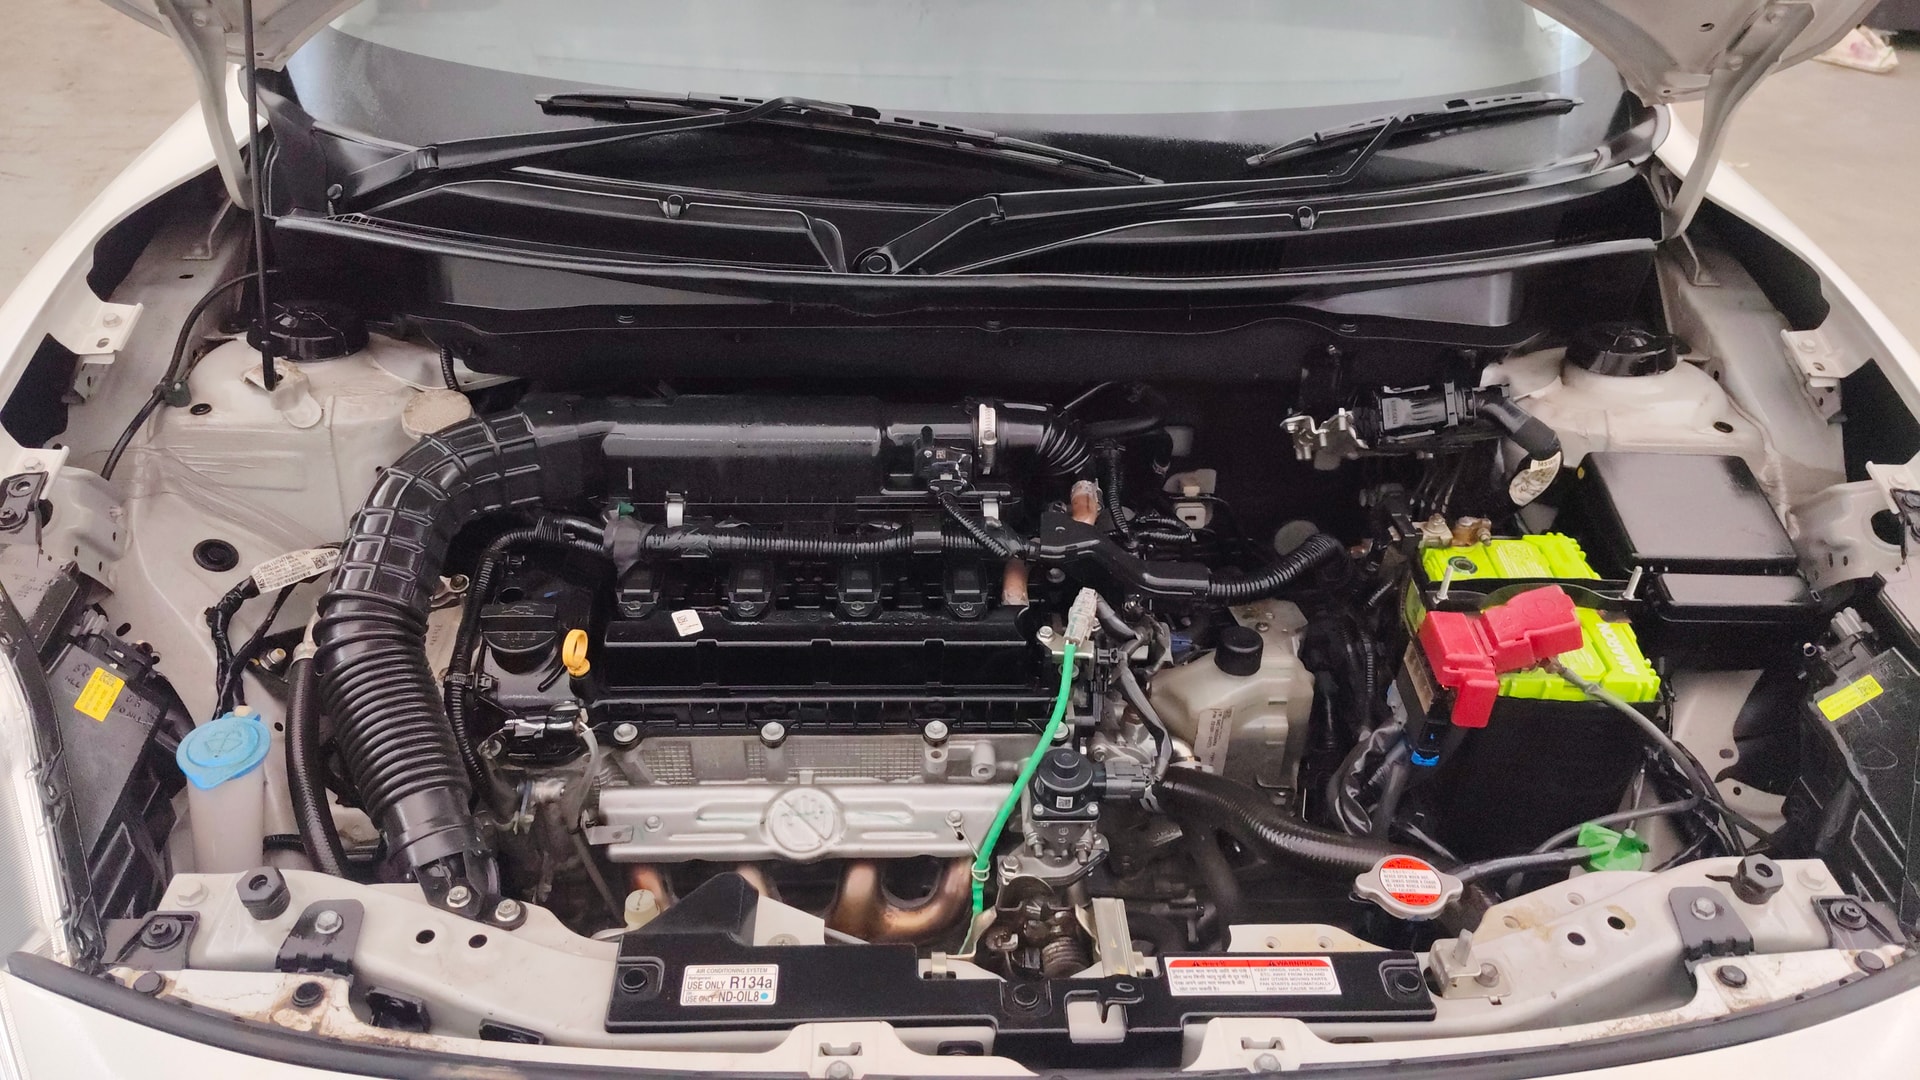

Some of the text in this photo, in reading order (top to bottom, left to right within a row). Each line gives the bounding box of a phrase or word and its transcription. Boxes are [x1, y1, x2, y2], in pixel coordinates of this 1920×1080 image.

[1595, 622, 1640, 676] AMARON
[687, 980, 726, 990] USE ONLY
[729, 976, 773, 989] R134a
[718, 991, 760, 1002] ND-OIL8
